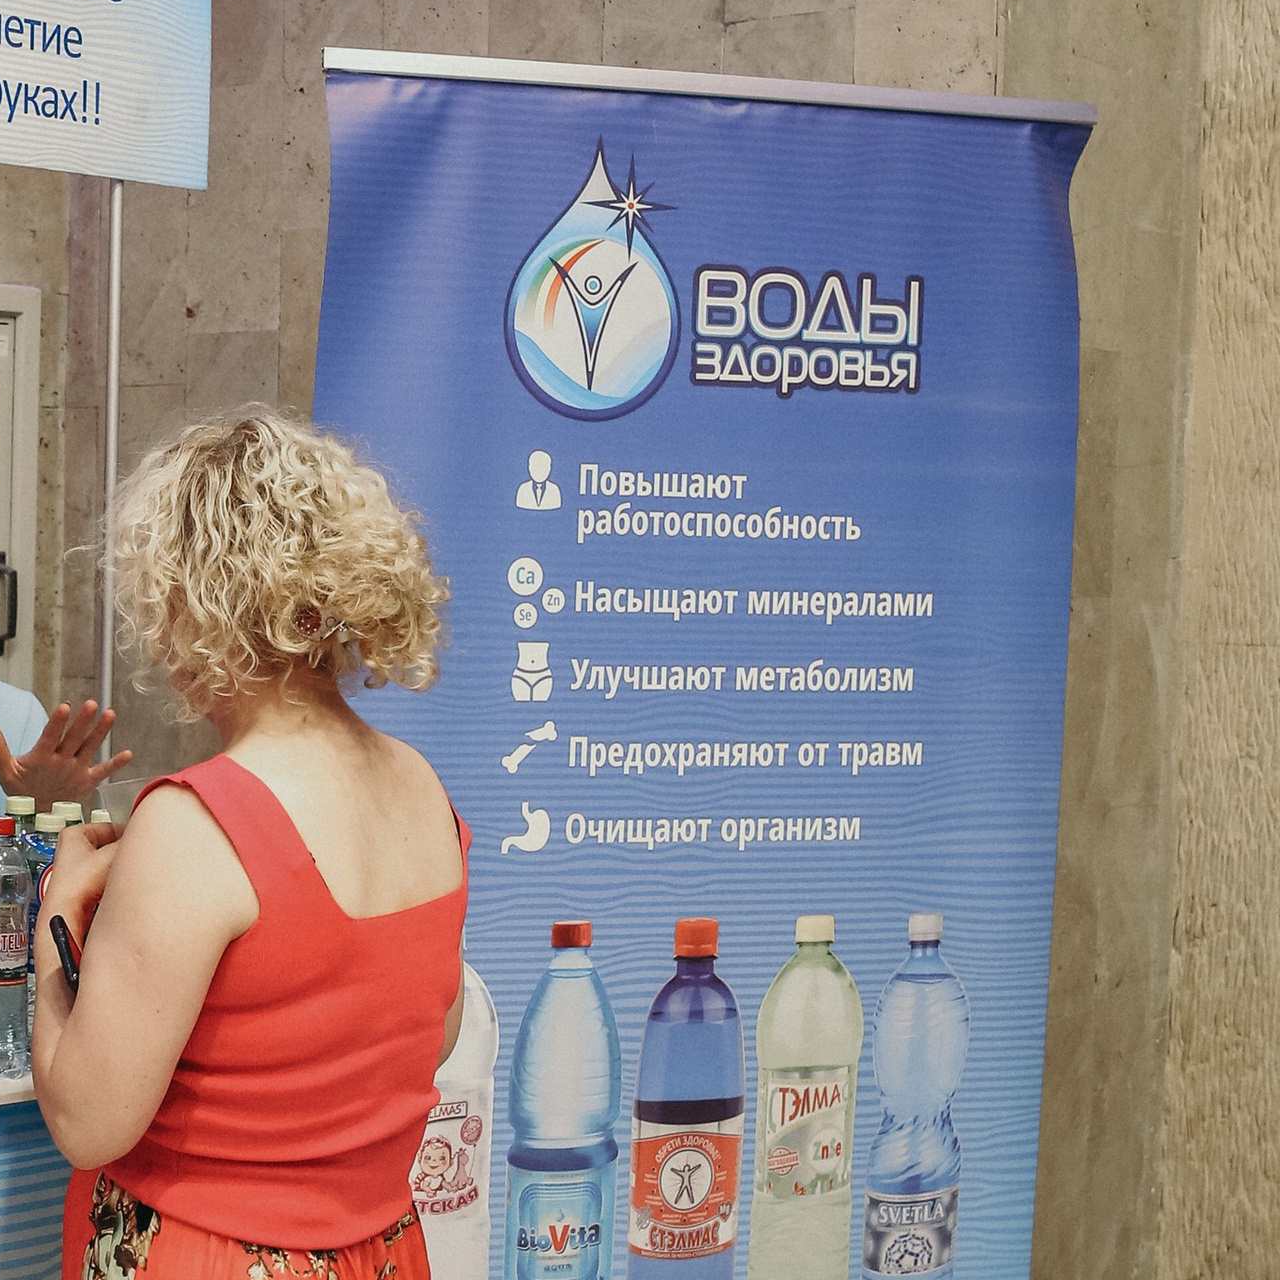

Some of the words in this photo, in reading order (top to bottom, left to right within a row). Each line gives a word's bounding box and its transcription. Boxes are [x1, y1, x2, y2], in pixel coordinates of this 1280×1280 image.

[694, 266, 922, 347] ВОДЫ
[578, 463, 747, 501] Повышают
[577, 503, 862, 543] работоспособность
[516, 567, 535, 585] Ca
[519, 609, 532, 623] Se
[547, 593, 561, 607] Zn
[574, 581, 739, 621] Насыщают
[747, 588, 933, 625] минералами
[570, 659, 727, 699] Улучшают
[734, 660, 914, 692] метаболизм
[568, 736, 789, 776] Предохраняют
[797, 741, 830, 767] от
[837, 739, 923, 775] травм
[564, 812, 712, 850] Очищают
[721, 815, 862, 851] организм
[655, 1138, 681, 1163] ОБРЕТИ
[879, 1200, 945, 1225] SVETLA
[517, 1223, 601, 1253] BioVita
[649, 1221, 720, 1251] СТЭЛМАС
